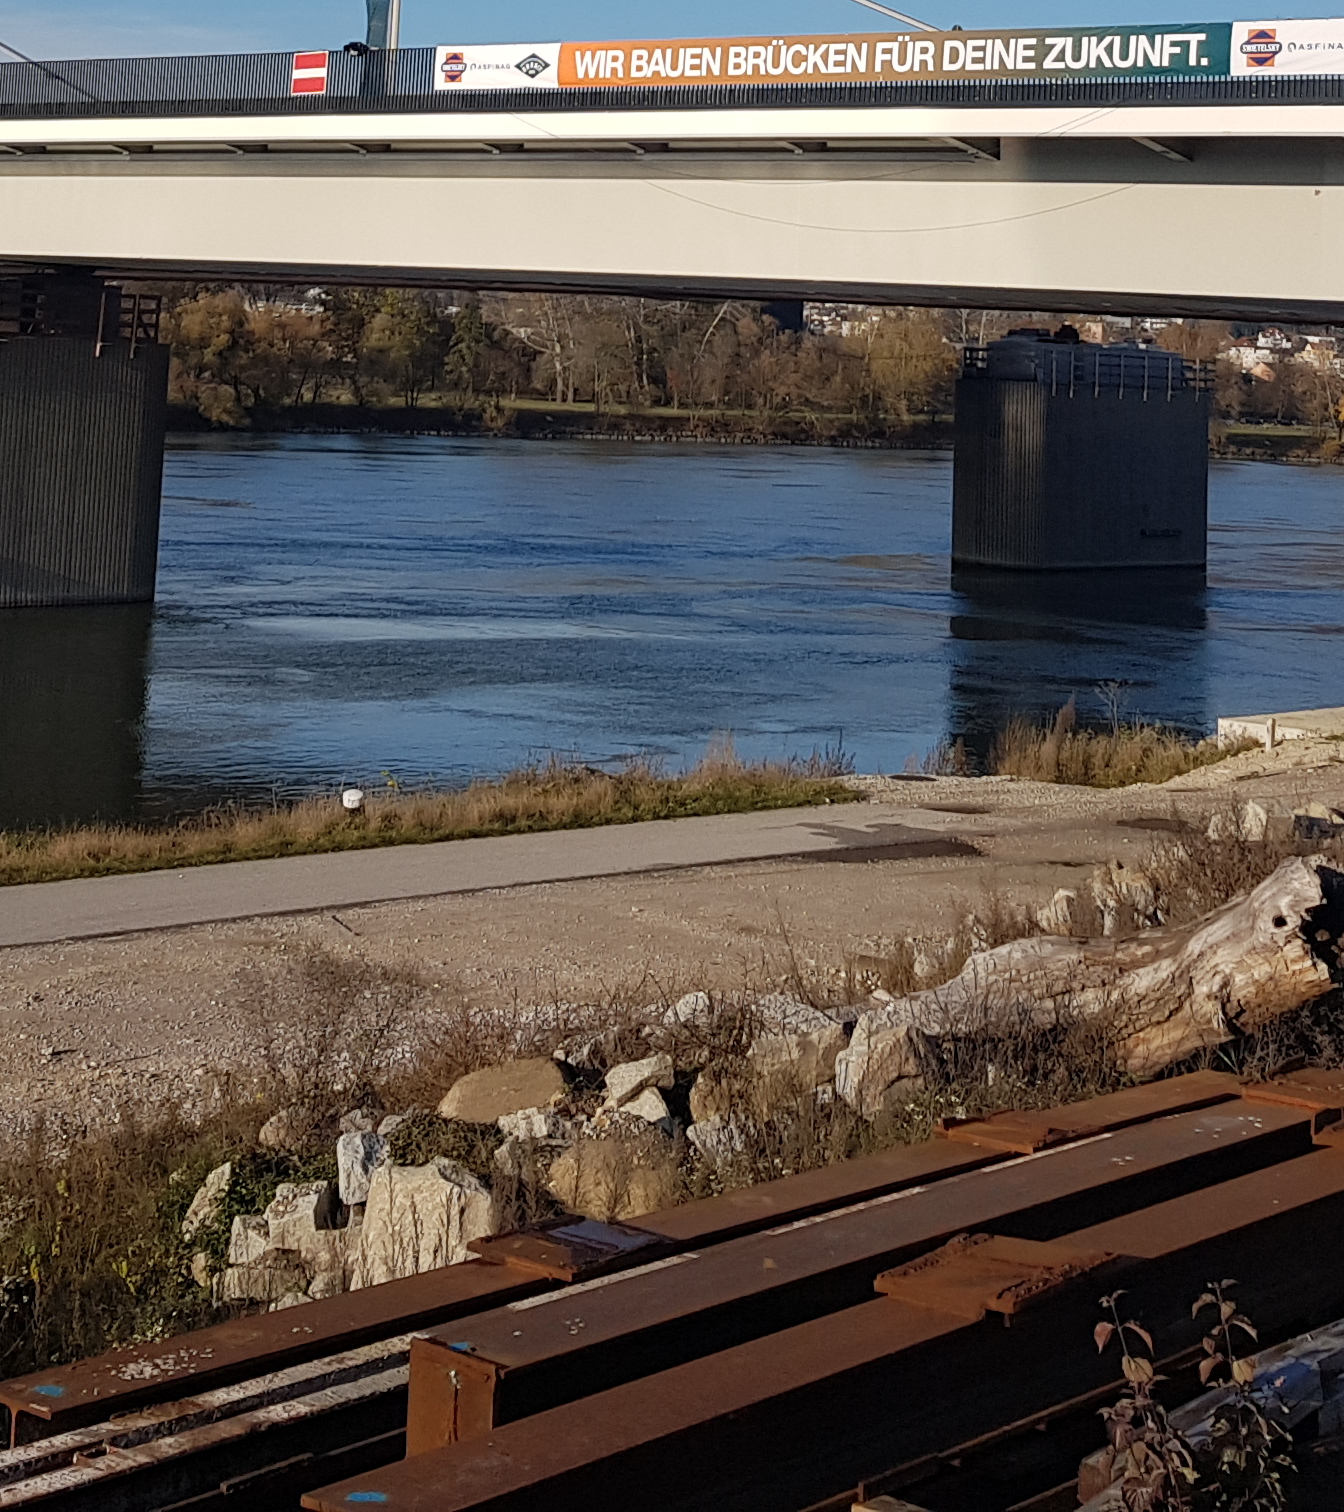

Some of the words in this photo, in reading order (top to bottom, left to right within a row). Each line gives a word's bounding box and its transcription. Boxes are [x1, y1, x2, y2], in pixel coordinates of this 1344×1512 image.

[574, 49, 625, 79] WIR
[630, 47, 721, 78] BAUEN
[727, 39, 868, 76] BRÜCKEN
[874, 35, 935, 73] FÜR
[942, 37, 1037, 71] DEINE
[1043, 33, 1209, 69] ZUKUNFT.
